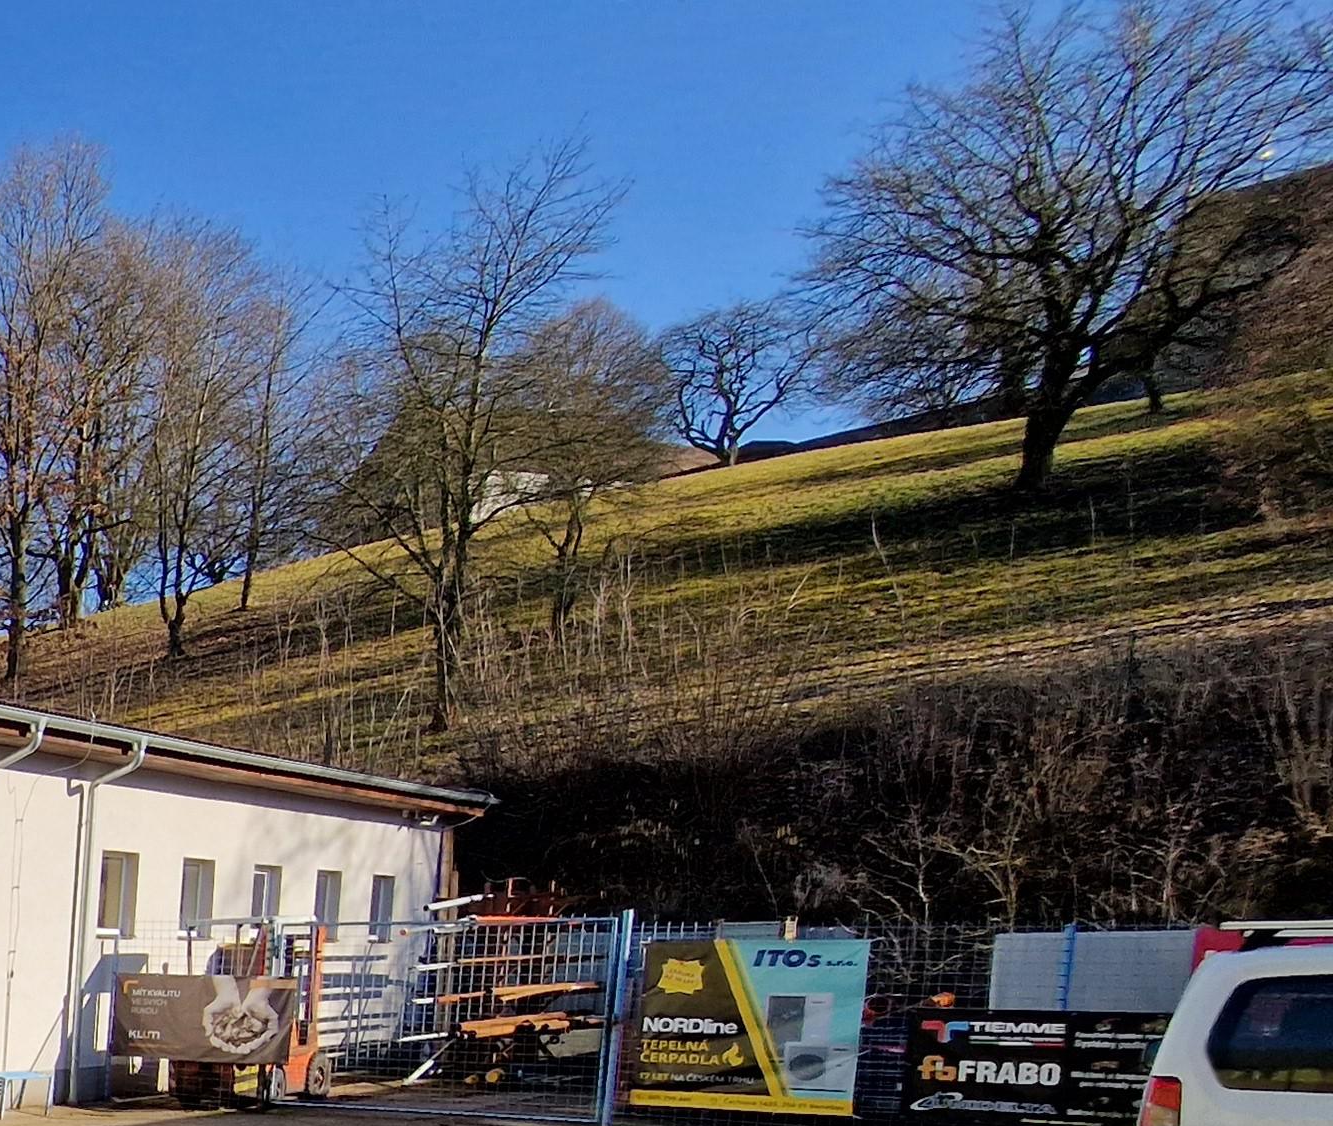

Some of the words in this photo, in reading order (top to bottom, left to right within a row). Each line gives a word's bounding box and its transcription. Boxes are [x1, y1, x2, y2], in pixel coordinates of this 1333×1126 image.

[753, 949, 822, 968] ITOs
[148, 988, 181, 998] KVALITU
[642, 1016, 738, 1034] NORDline
[969, 1021, 1066, 1034] TIEMME
[641, 1039, 710, 1051] TEPELNÁ
[640, 1049, 720, 1065] ČERPADLA
[652, 1073, 670, 1081] LET
[958, 1060, 1061, 1086] FRABO
